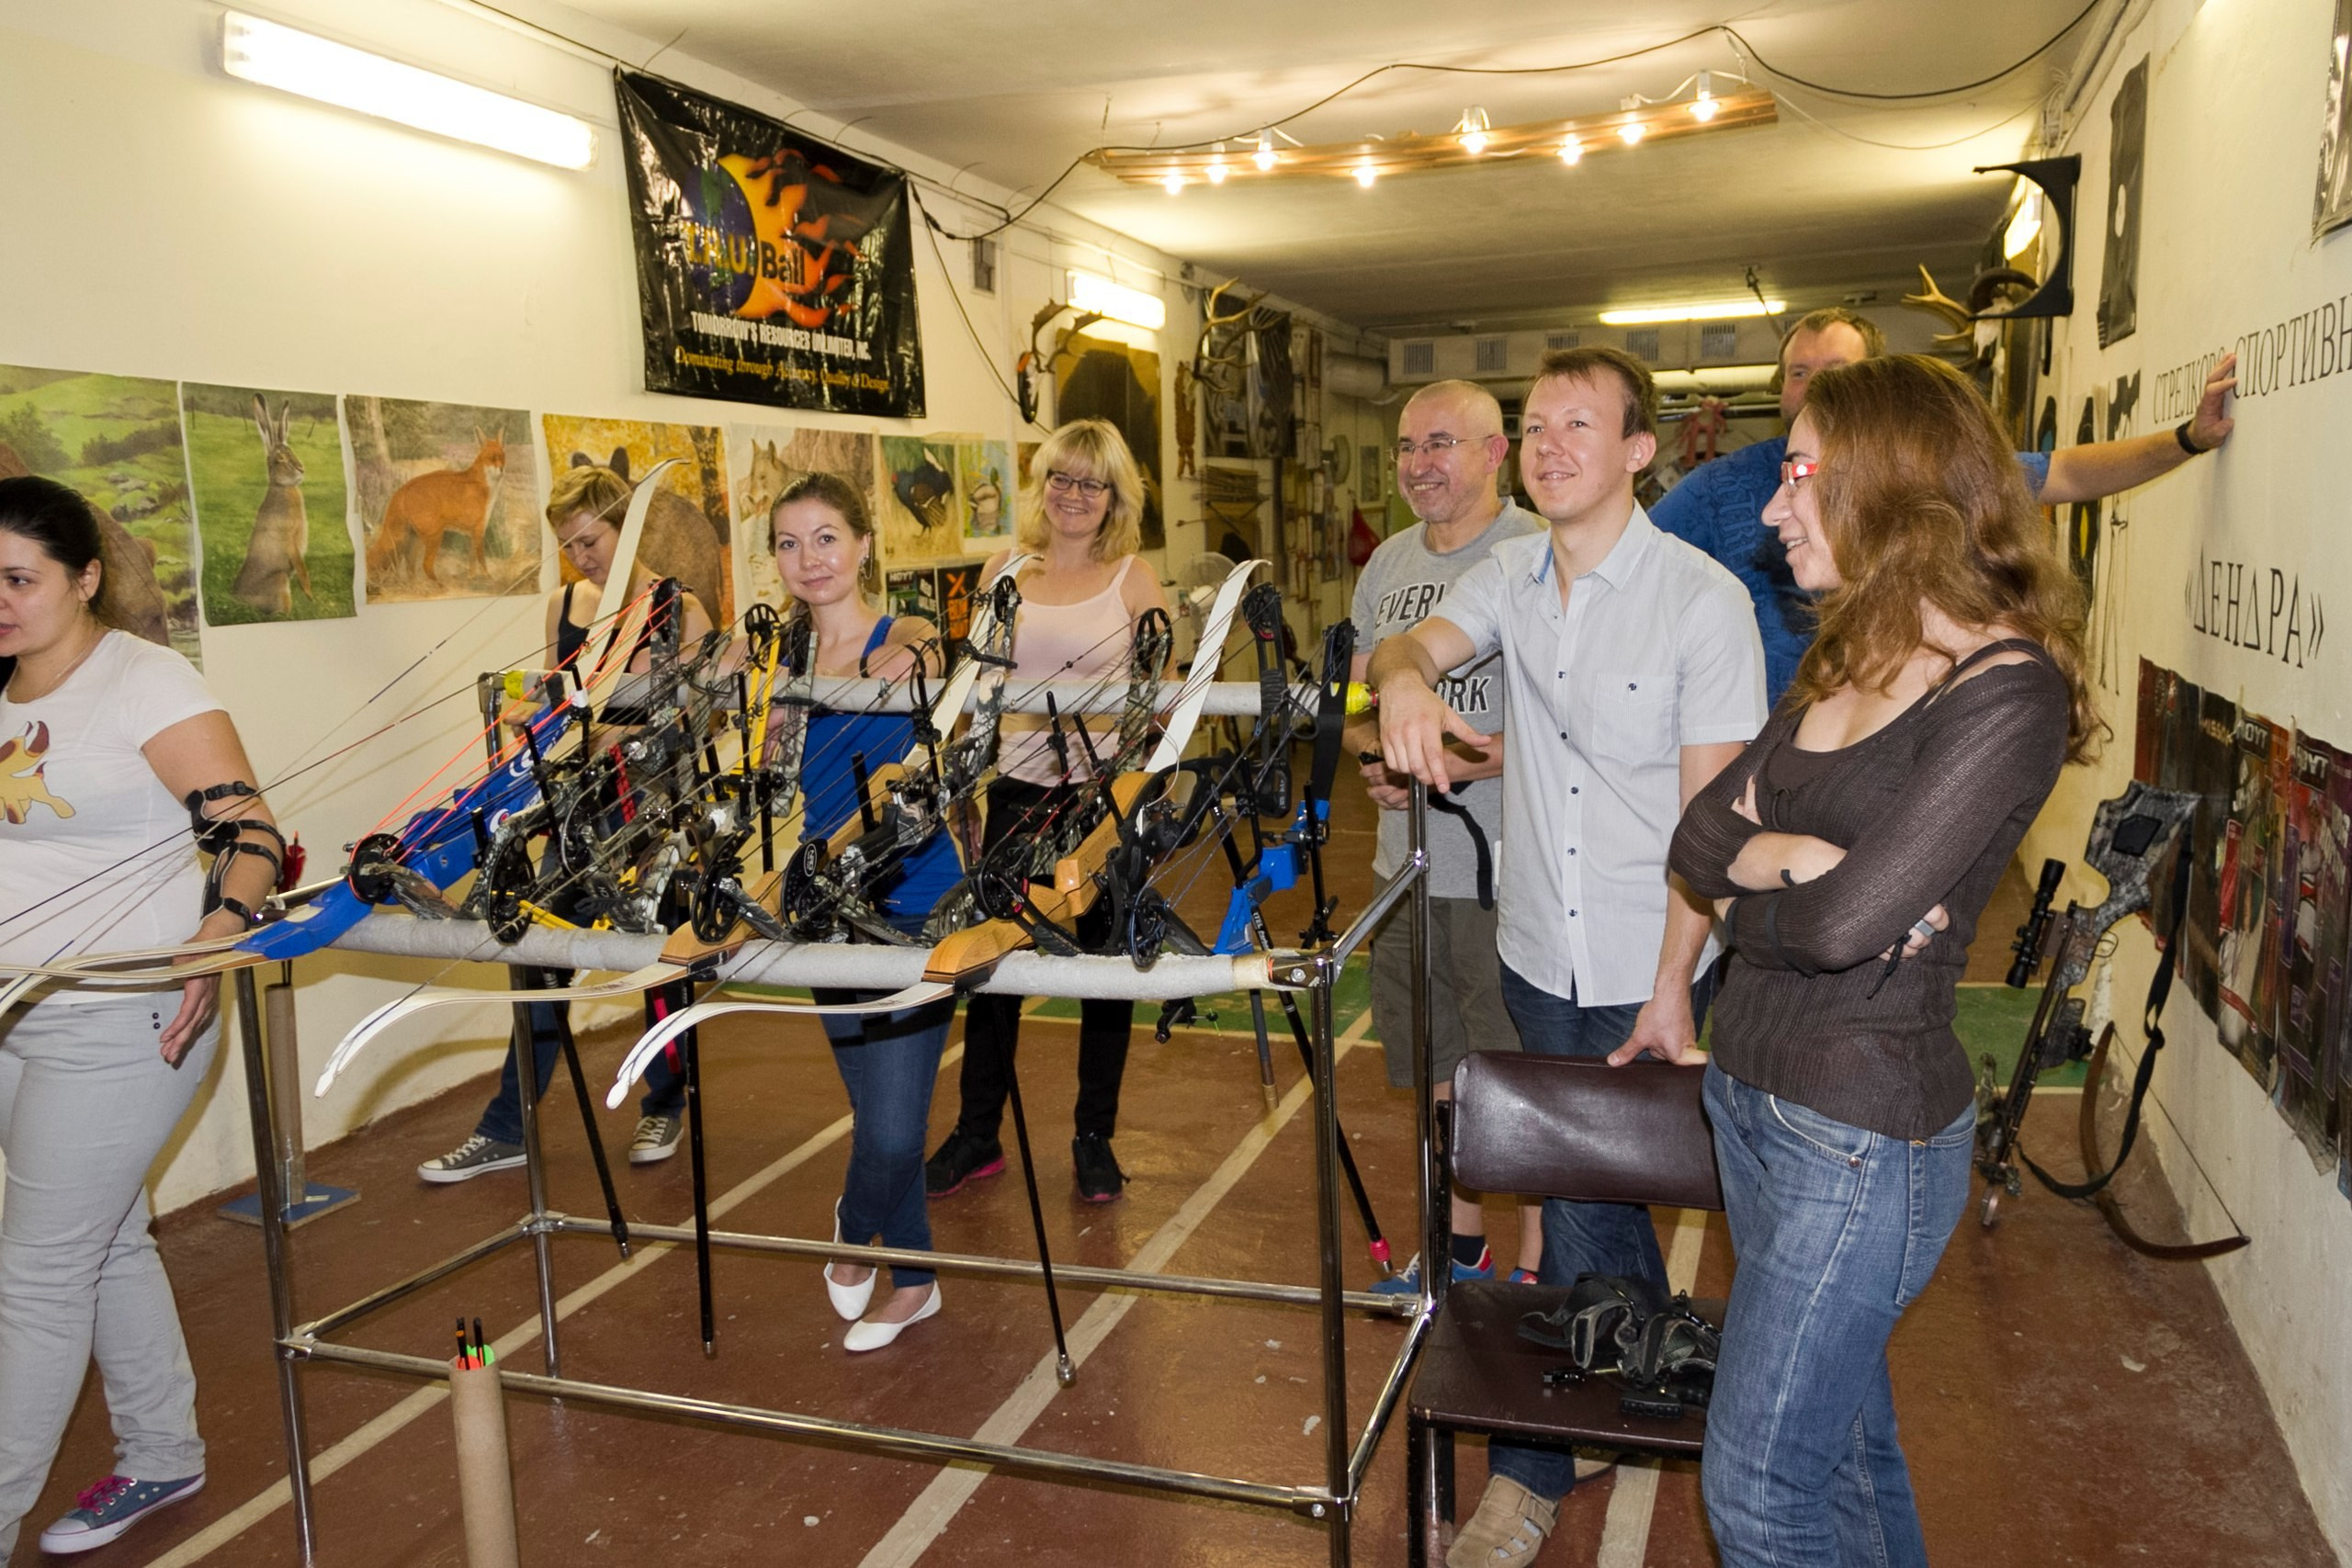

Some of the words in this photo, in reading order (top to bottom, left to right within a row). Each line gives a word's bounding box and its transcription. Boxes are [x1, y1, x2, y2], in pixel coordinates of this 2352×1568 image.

[761, 241, 806, 286] Ball
[691, 310, 758, 342] TOMORROW'S
[759, 323, 810, 351] RESOURCES
[888, 570, 914, 582] HOYT
[1435, 677, 1490, 713] ORK
